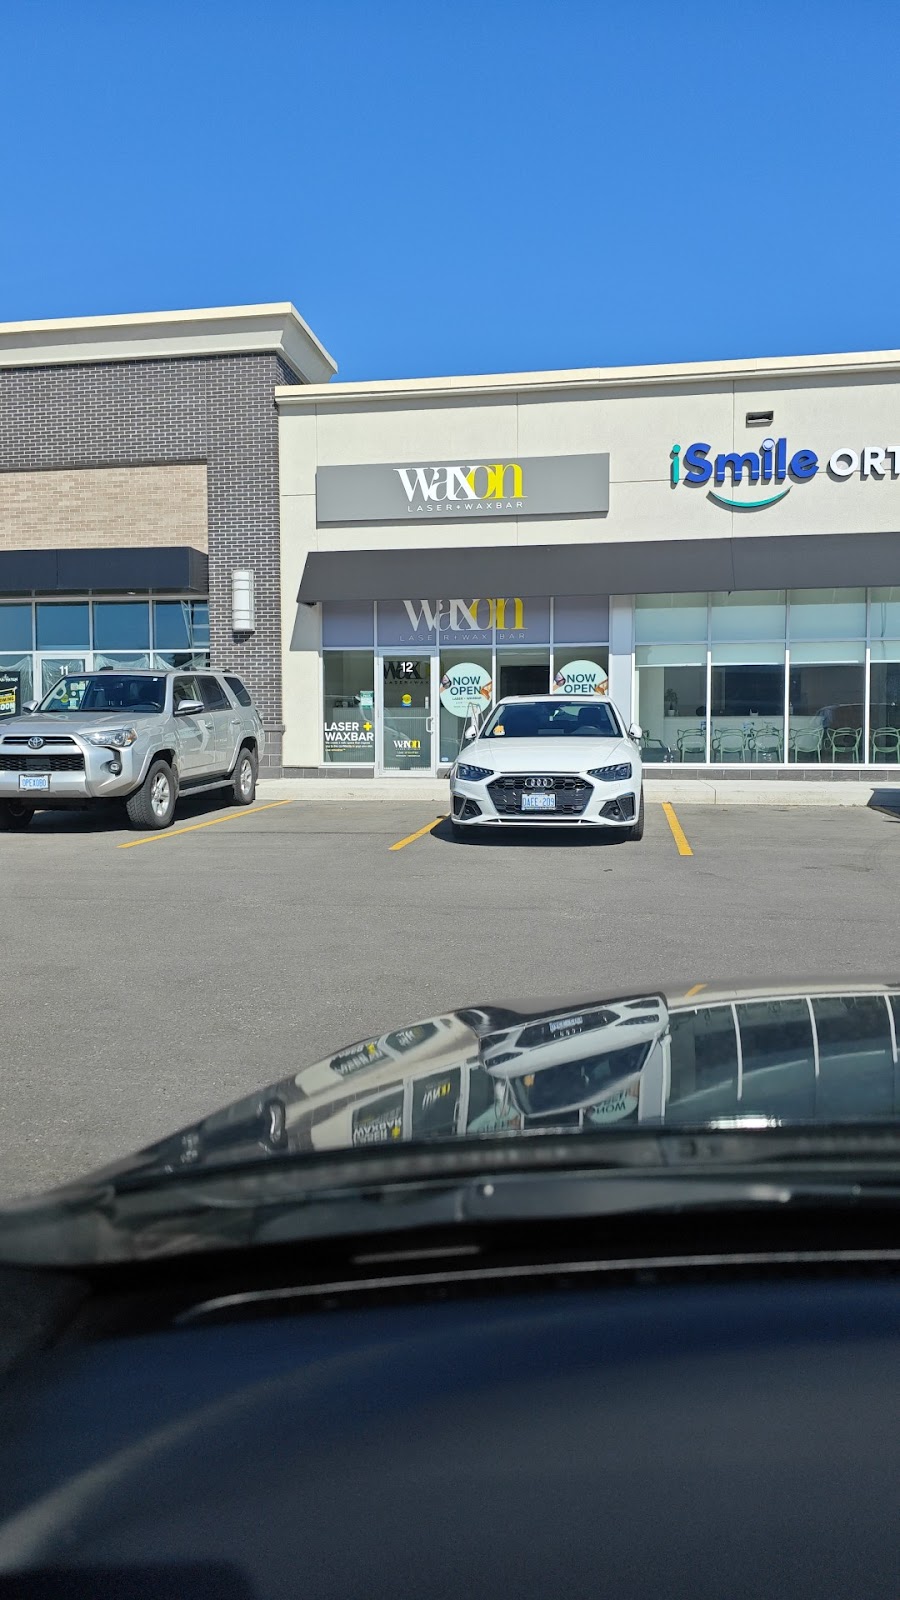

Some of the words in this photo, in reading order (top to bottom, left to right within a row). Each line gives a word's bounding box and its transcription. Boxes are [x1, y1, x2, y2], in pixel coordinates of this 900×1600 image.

[671, 438, 819, 484] iSmile
[393, 463, 528, 503] waxon
[59, 666, 69, 676] 11
[401, 662, 413, 673] 12
[452, 676, 481, 686] NOW
[566, 673, 596, 683] NOW
[450, 686, 482, 696] OPEN
[564, 683, 597, 694] OPEN
[324, 722, 360, 731] LASER
[324, 732, 374, 741] WAXBAR
